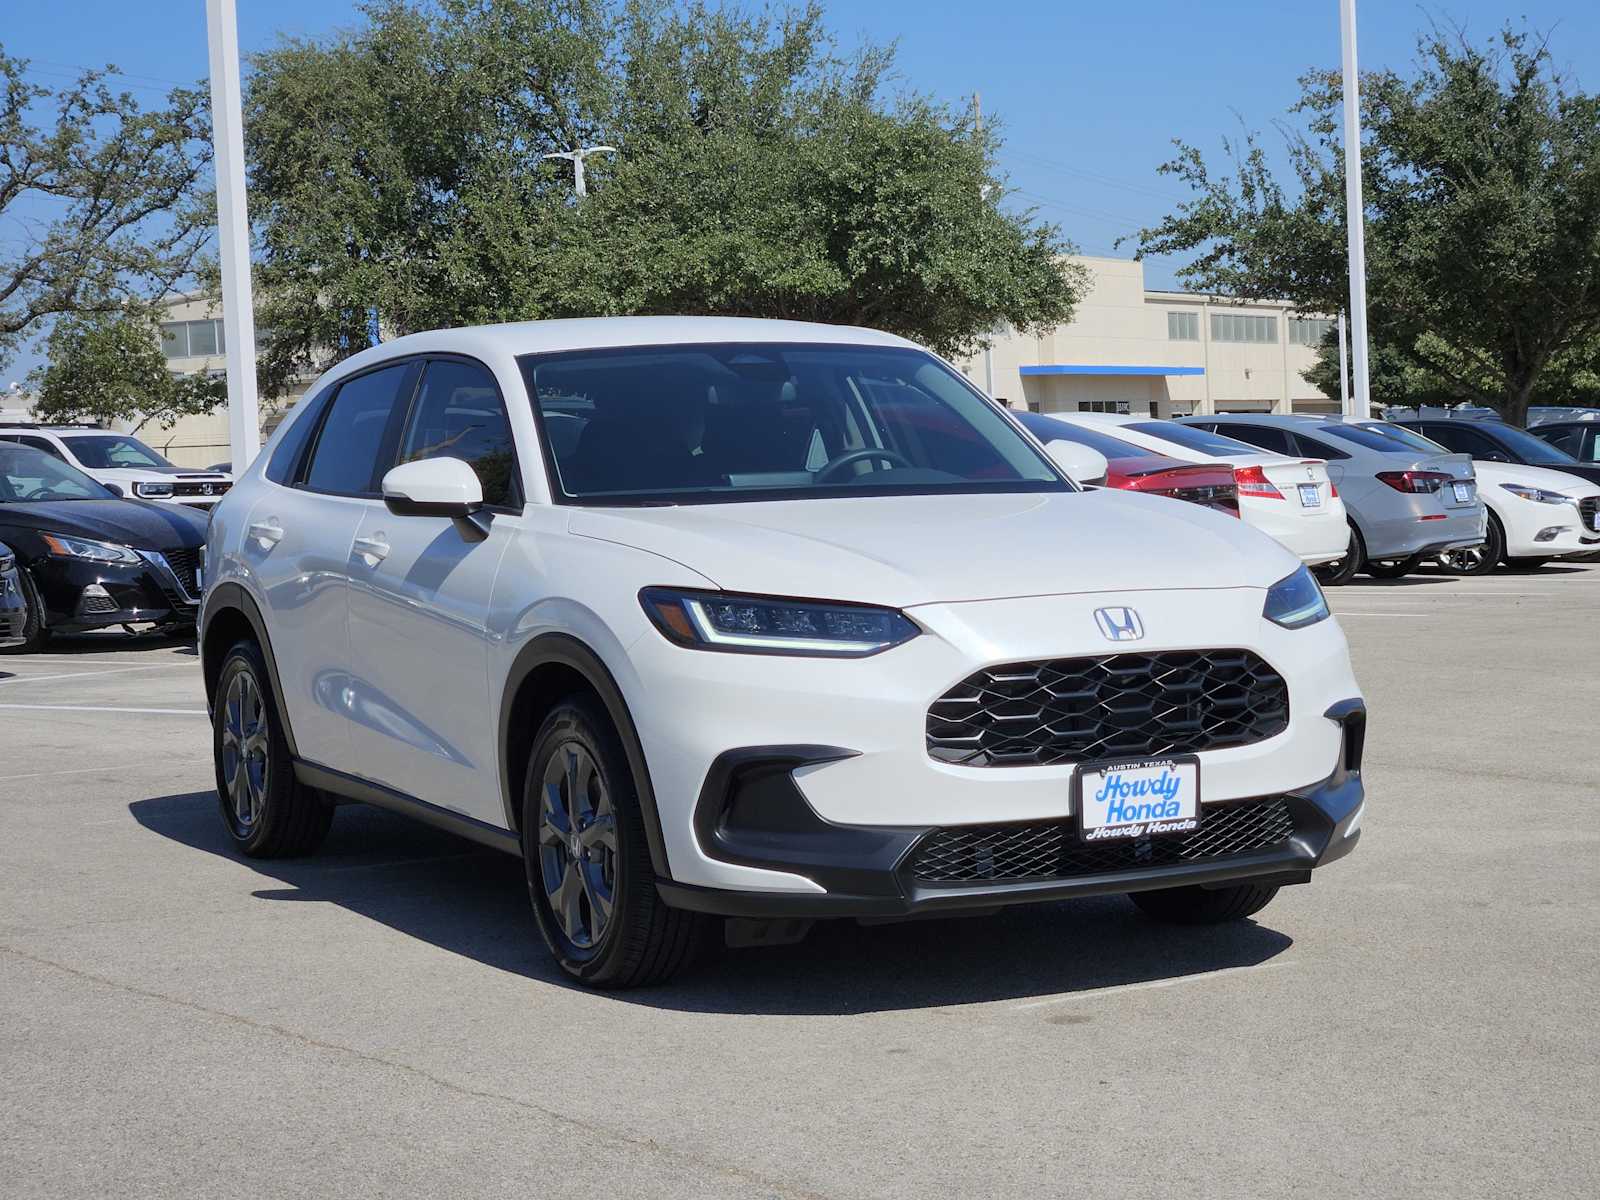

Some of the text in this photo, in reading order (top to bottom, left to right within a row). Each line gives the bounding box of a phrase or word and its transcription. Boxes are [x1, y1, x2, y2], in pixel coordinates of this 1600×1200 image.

[1107, 760, 1173, 771] AUSTIN TEXAS
[1095, 770, 1181, 802] Howdy
[1105, 799, 1181, 823] Honda
[1086, 819, 1197, 840] Howdy Honda
